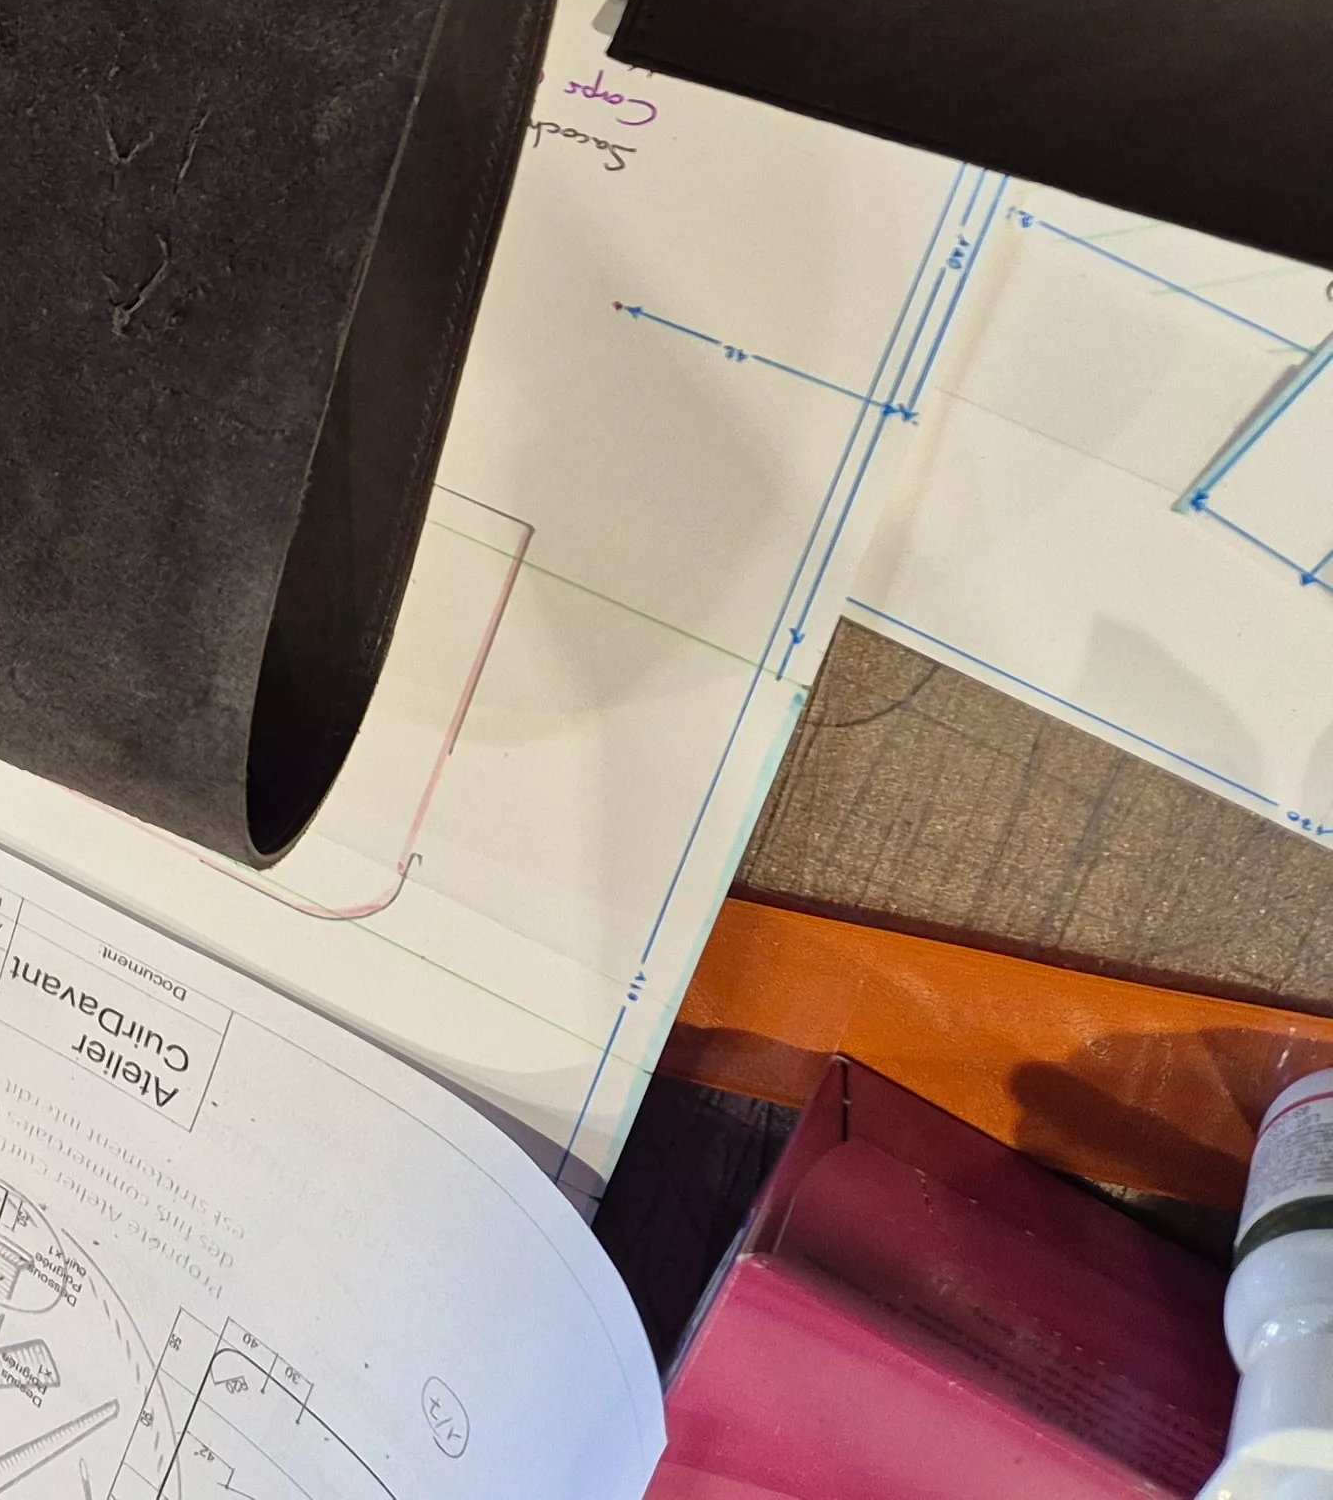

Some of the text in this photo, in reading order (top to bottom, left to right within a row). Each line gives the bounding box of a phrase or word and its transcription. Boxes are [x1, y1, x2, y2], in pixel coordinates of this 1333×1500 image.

[563, 70, 659, 127] Corps
[97, 944, 188, 1003] Document:
[9, 955, 190, 1073] CuirDavant
[70, 1033, 180, 1108] Atelier
[241, 1330, 263, 1349] 40
[283, 1363, 304, 1385] 30
